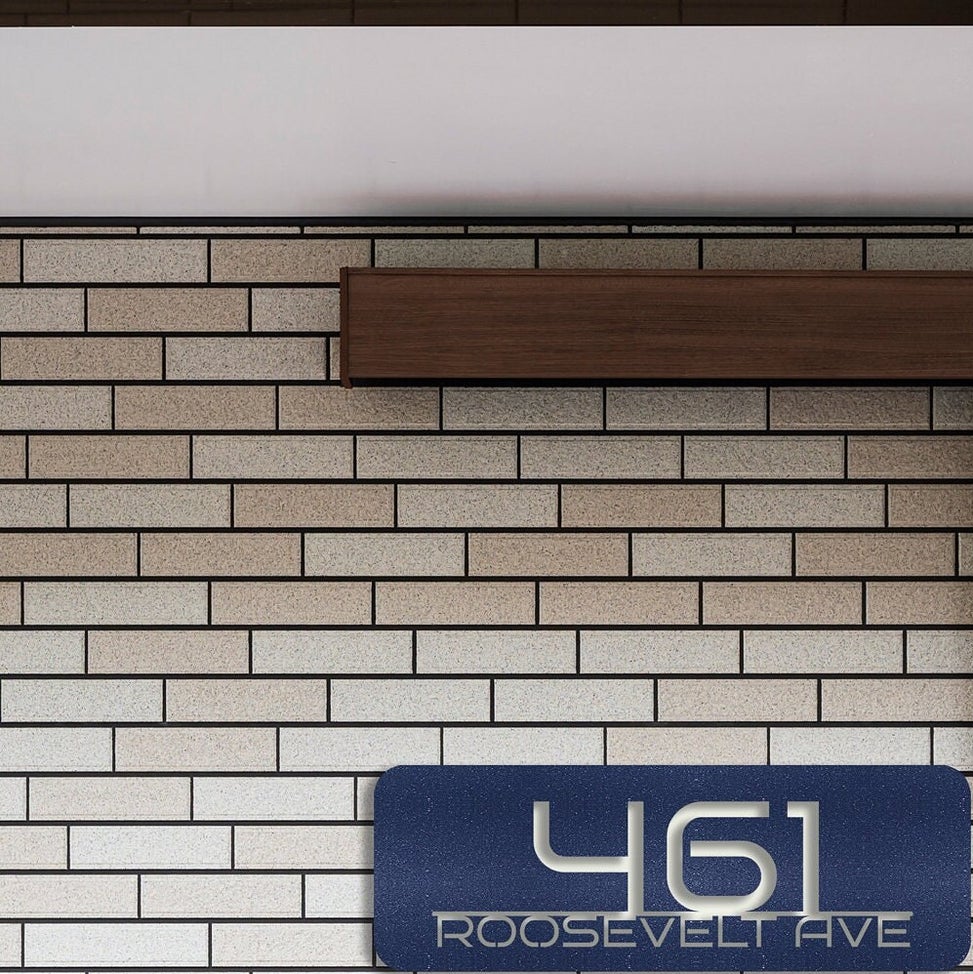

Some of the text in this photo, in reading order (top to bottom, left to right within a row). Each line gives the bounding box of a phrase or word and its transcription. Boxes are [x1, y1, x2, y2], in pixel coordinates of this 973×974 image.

[533, 800, 820, 915] 461
[436, 914, 911, 948] ROOSEVELT AVE
